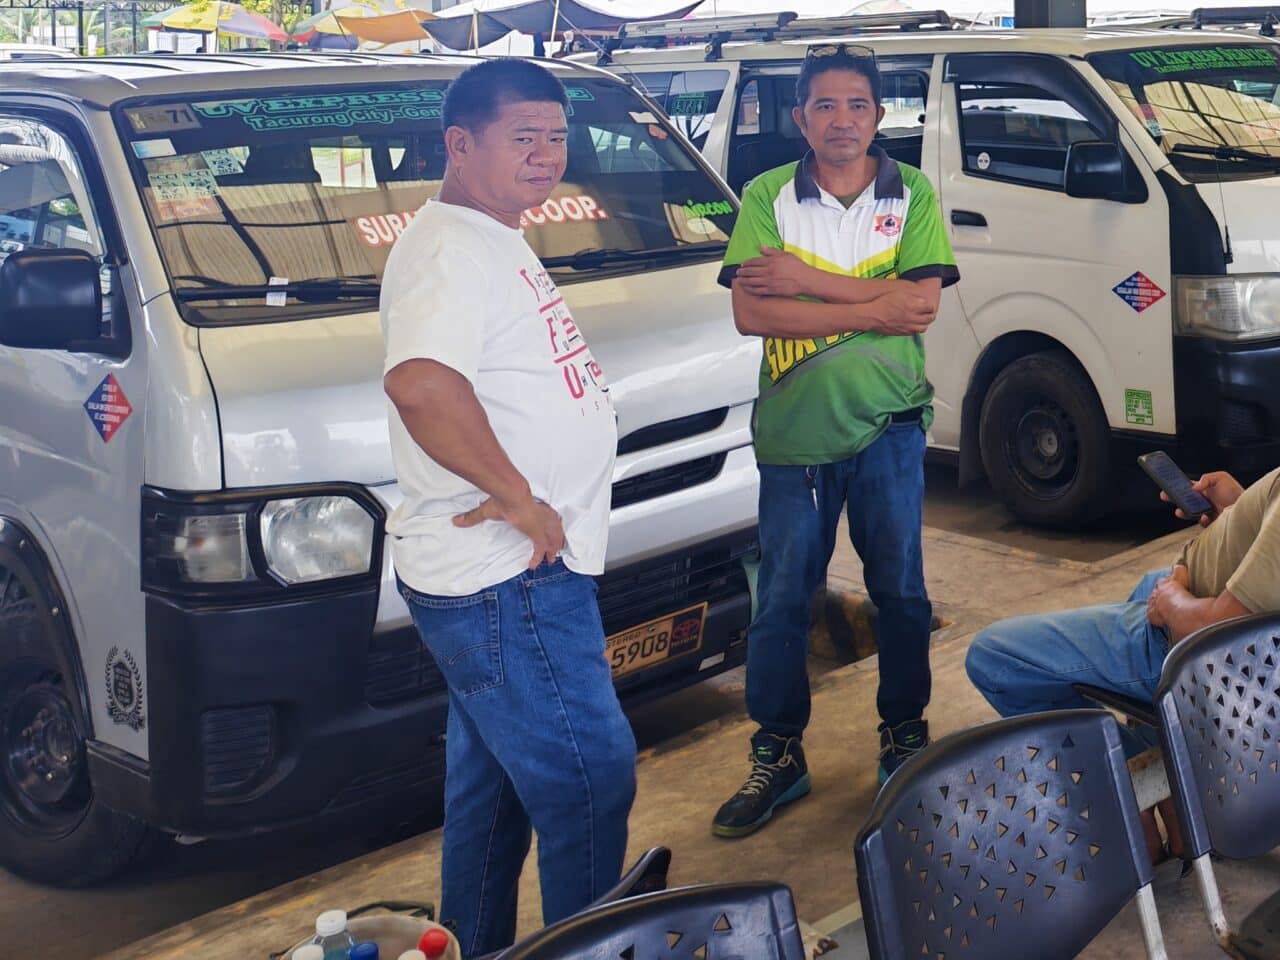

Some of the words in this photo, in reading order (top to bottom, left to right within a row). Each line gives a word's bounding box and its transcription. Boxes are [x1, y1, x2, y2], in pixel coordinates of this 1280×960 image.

[198, 99, 257, 117] UV
[261, 90, 444, 113] EXPRESS
[248, 111, 351, 130] Tacurong
